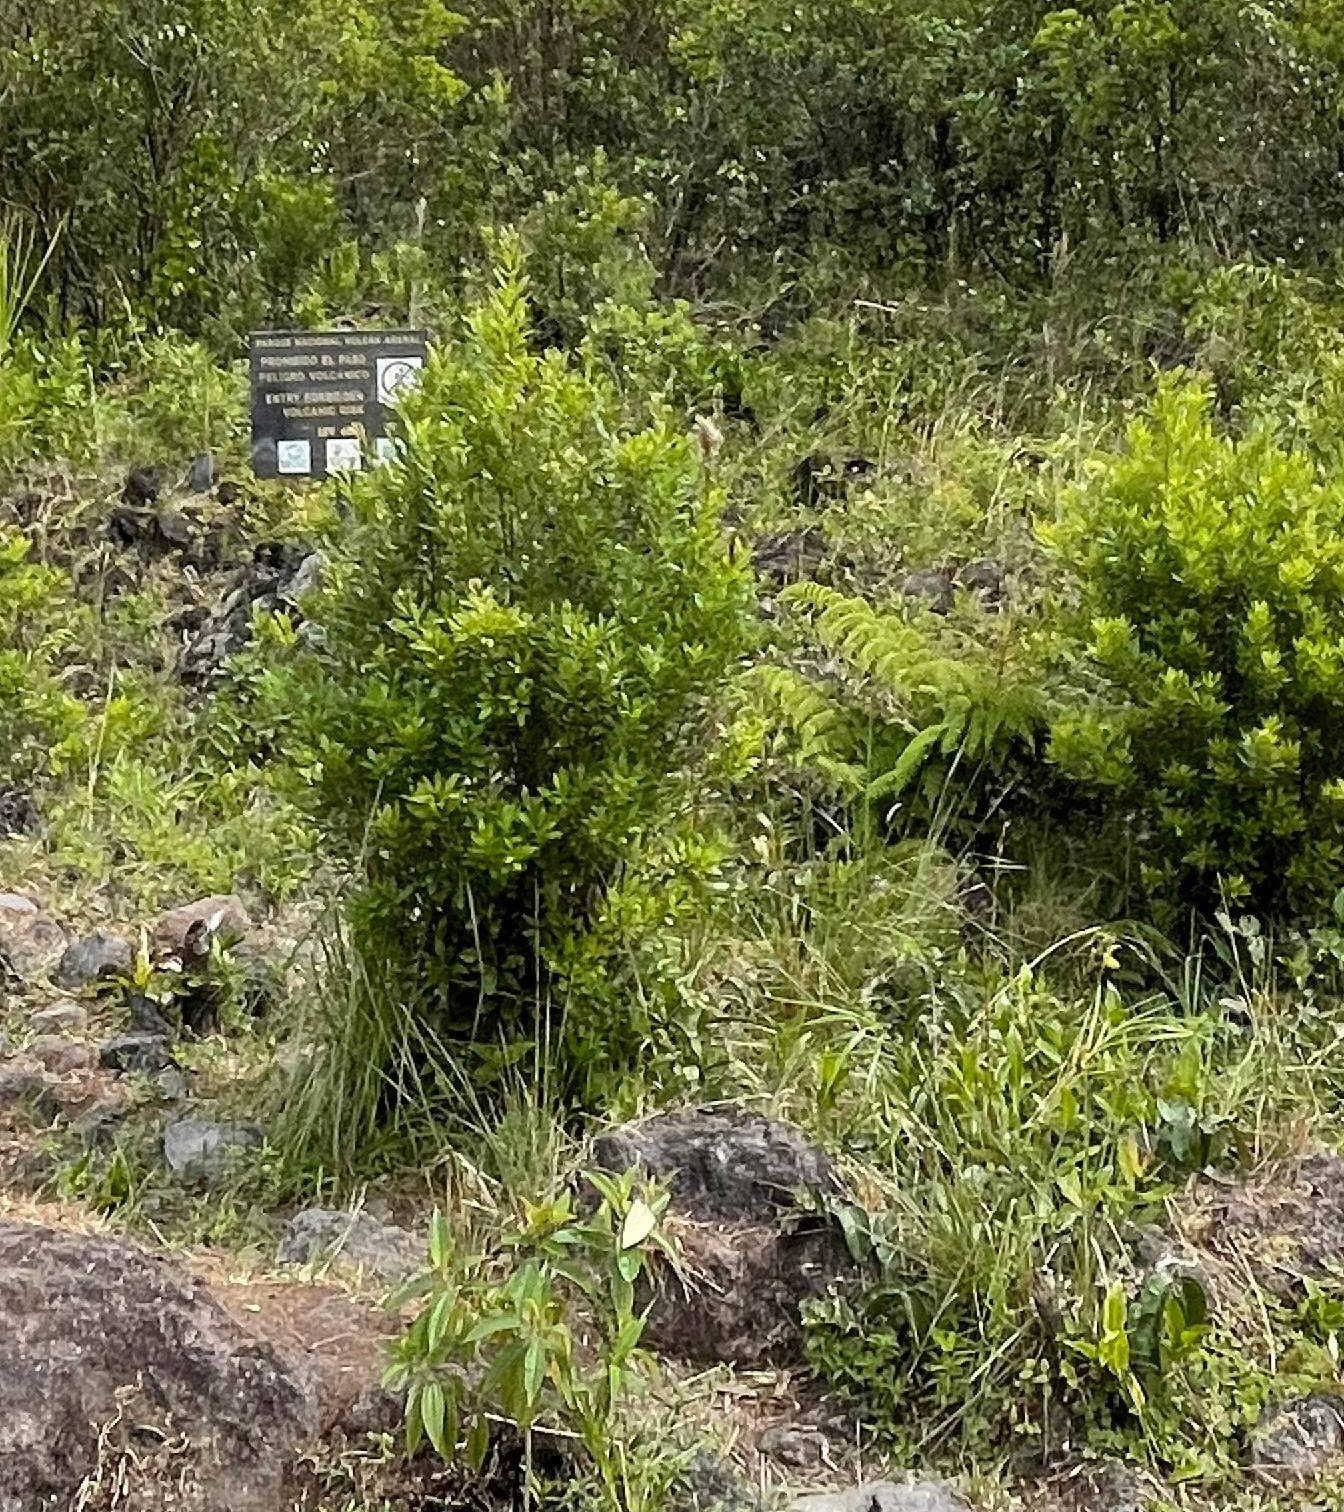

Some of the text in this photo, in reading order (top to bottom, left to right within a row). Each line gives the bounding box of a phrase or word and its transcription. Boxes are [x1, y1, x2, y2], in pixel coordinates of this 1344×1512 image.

[321, 354, 334, 366] EL
[338, 354, 366, 366] PASO
[259, 370, 305, 382] PELIGRO
[265, 392, 301, 404] ENTRY
[283, 405, 336, 418] VOLCANIC
